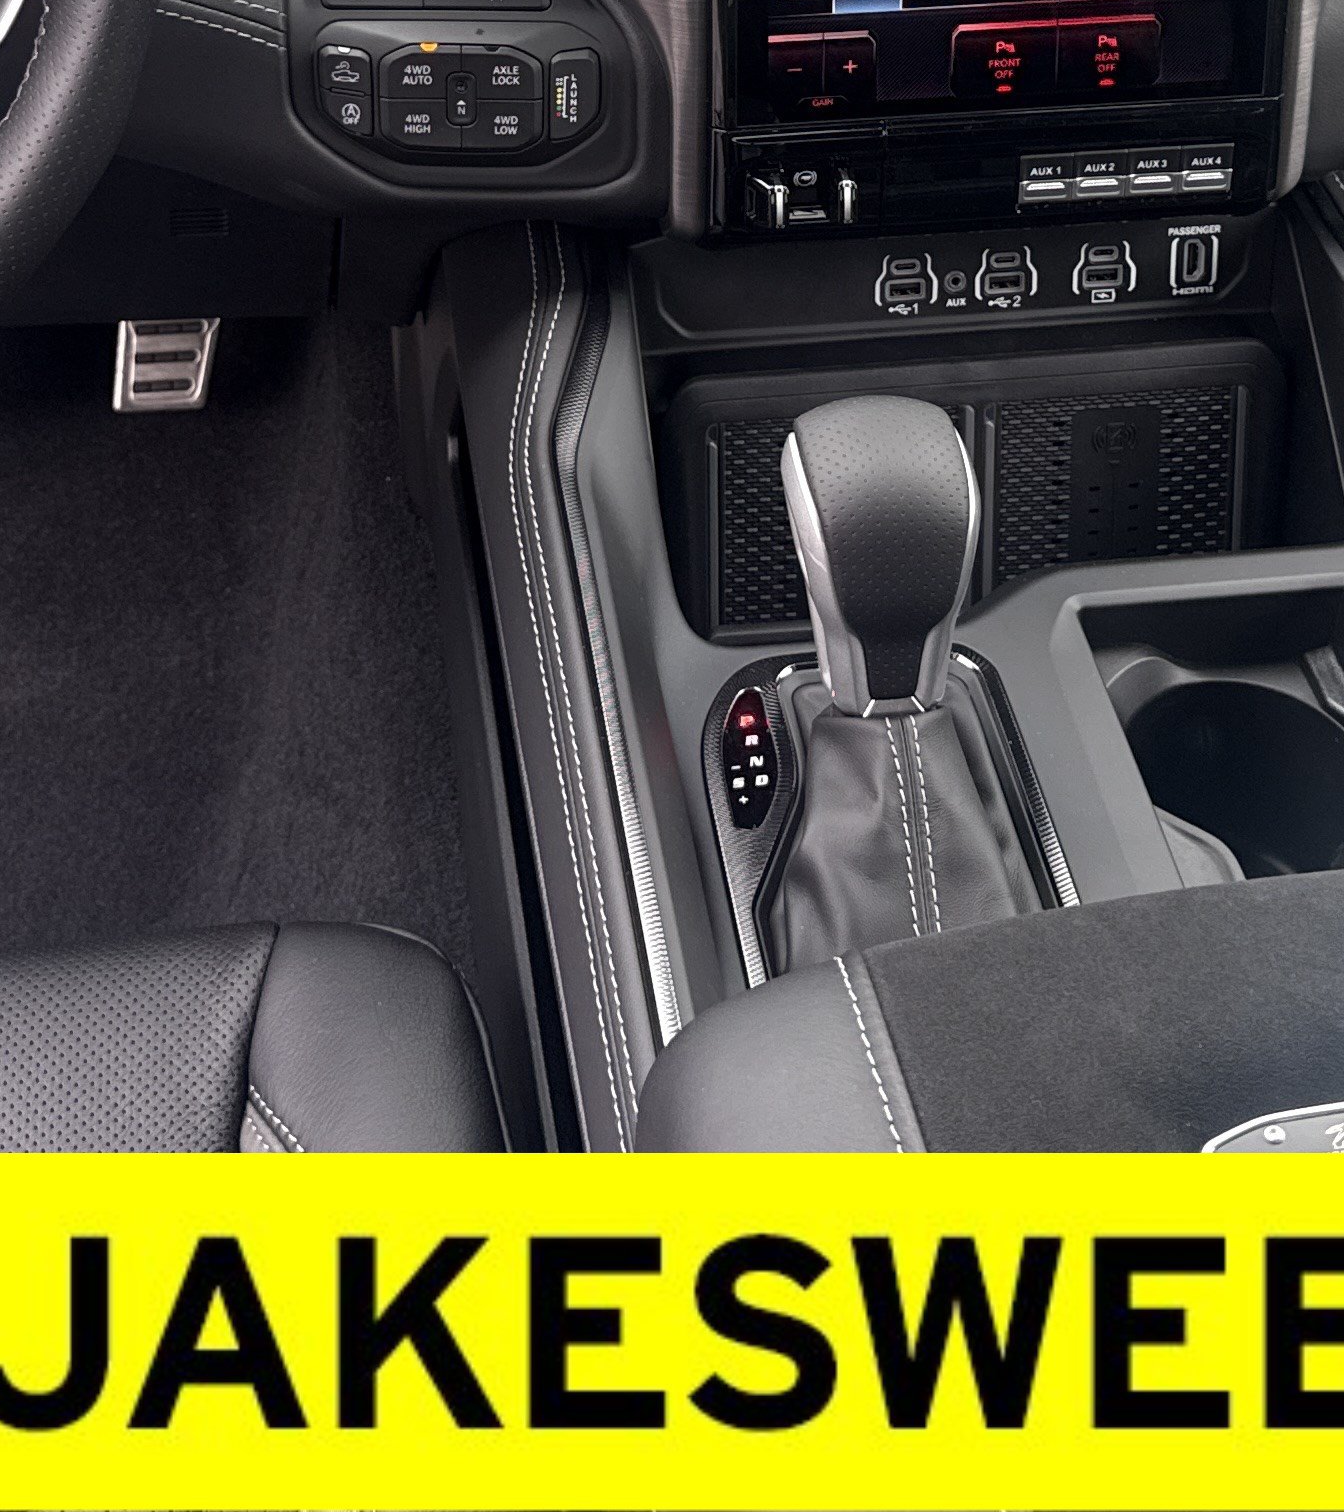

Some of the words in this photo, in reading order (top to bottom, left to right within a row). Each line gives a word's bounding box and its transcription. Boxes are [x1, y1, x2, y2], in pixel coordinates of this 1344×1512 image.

[1094, 52, 1120, 62] REAR
[988, 58, 1022, 68] FRONT
[404, 65, 431, 75] 4WD
[493, 65, 520, 75] AXLE
[1097, 64, 1116, 73] OFF
[994, 69, 1014, 79] OFF
[403, 75, 433, 86] AUTO
[492, 75, 520, 86] LOCK
[813, 97, 834, 107] GAIN
[458, 105, 466, 115] N
[405, 114, 430, 125] 4WD
[493, 115, 518, 125] 4WD
[404, 124, 431, 134] HIGH
[494, 125, 518, 135] LOW
[1137, 160, 1159, 169] AUX
[1161, 159, 1168, 168] 3
[1191, 157, 1213, 166] AUX
[1213, 156, 1222, 165] 4
[1030, 167, 1053, 176] AUX
[1056, 166, 1061, 175] 1
[1084, 164, 1106, 173] AUX
[1108, 163, 1116, 171] 2
[1168, 224, 1221, 236] PASSENGER
[945, 298, 966, 307] AUX
[1013, 295, 1022, 308] 2
[912, 303, 919, 315] 1
[745, 735, 759, 746] R
[749, 755, 764, 767] N
[755, 774, 769, 786] D
